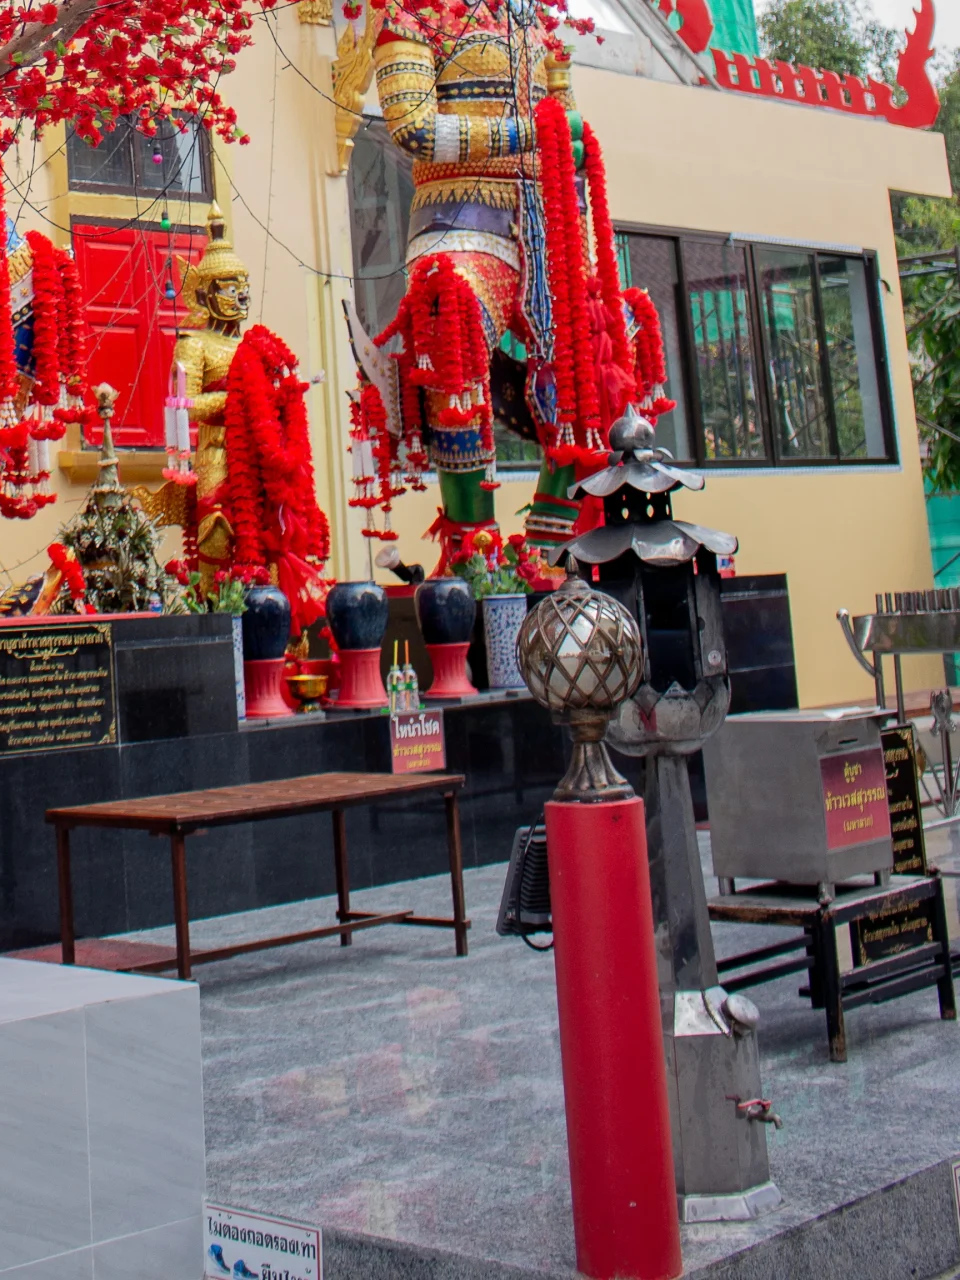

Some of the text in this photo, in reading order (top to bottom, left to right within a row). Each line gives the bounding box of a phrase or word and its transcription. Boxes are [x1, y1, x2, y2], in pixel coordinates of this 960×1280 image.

[843, 761, 862, 783] ตู้บูชา
[825, 786, 886, 813] ท้าวเวสสุวรรณ
[207, 1212, 316, 1260] ไม่ต้องถอดรองเท้า
